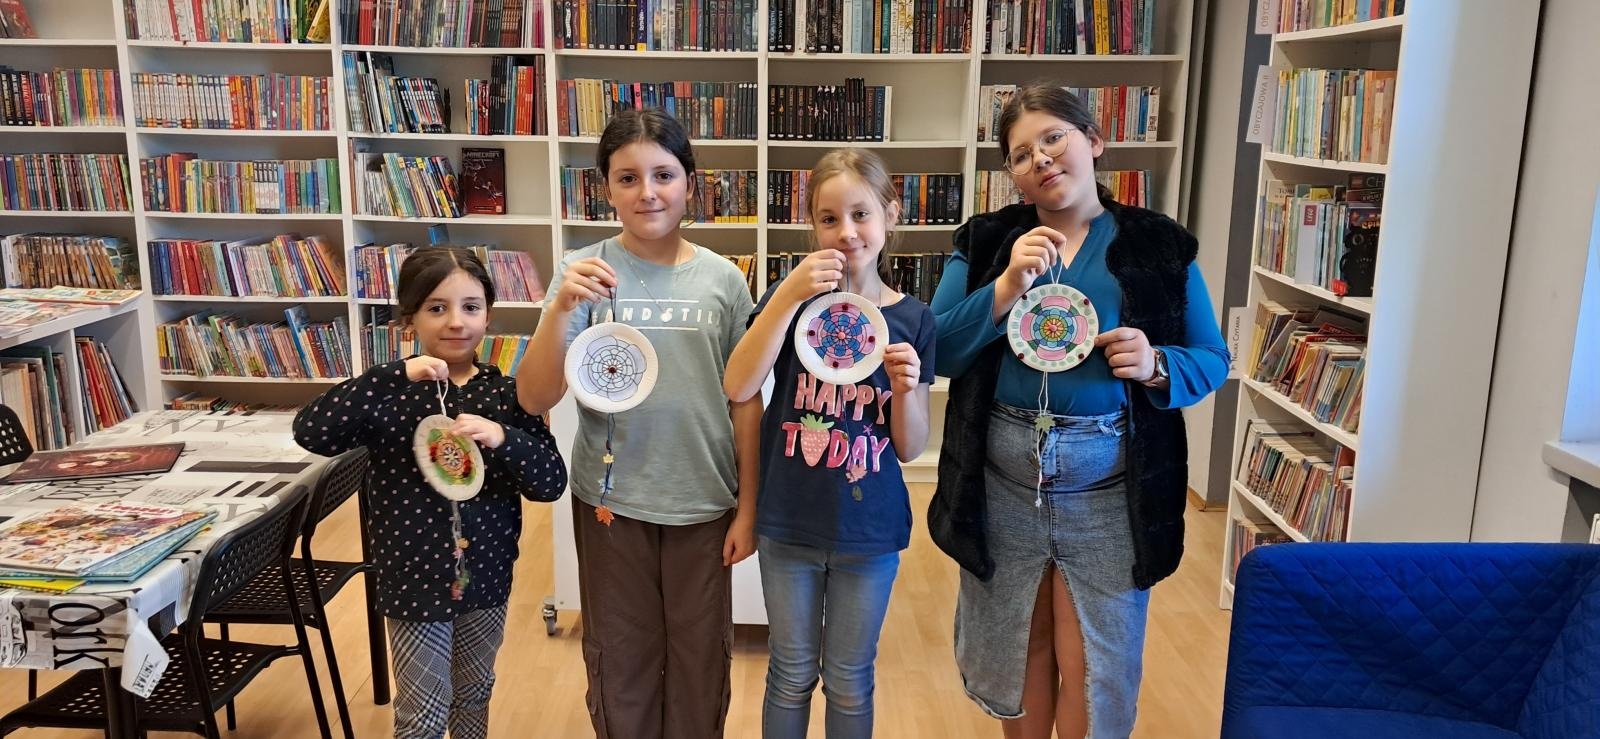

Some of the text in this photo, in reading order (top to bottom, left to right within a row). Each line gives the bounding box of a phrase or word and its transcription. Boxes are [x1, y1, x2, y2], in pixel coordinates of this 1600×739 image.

[1252, 82, 1269, 135] OBYCZAJOWA
[794, 372, 892, 425] HAPPY
[782, 414, 890, 473] TODAY
